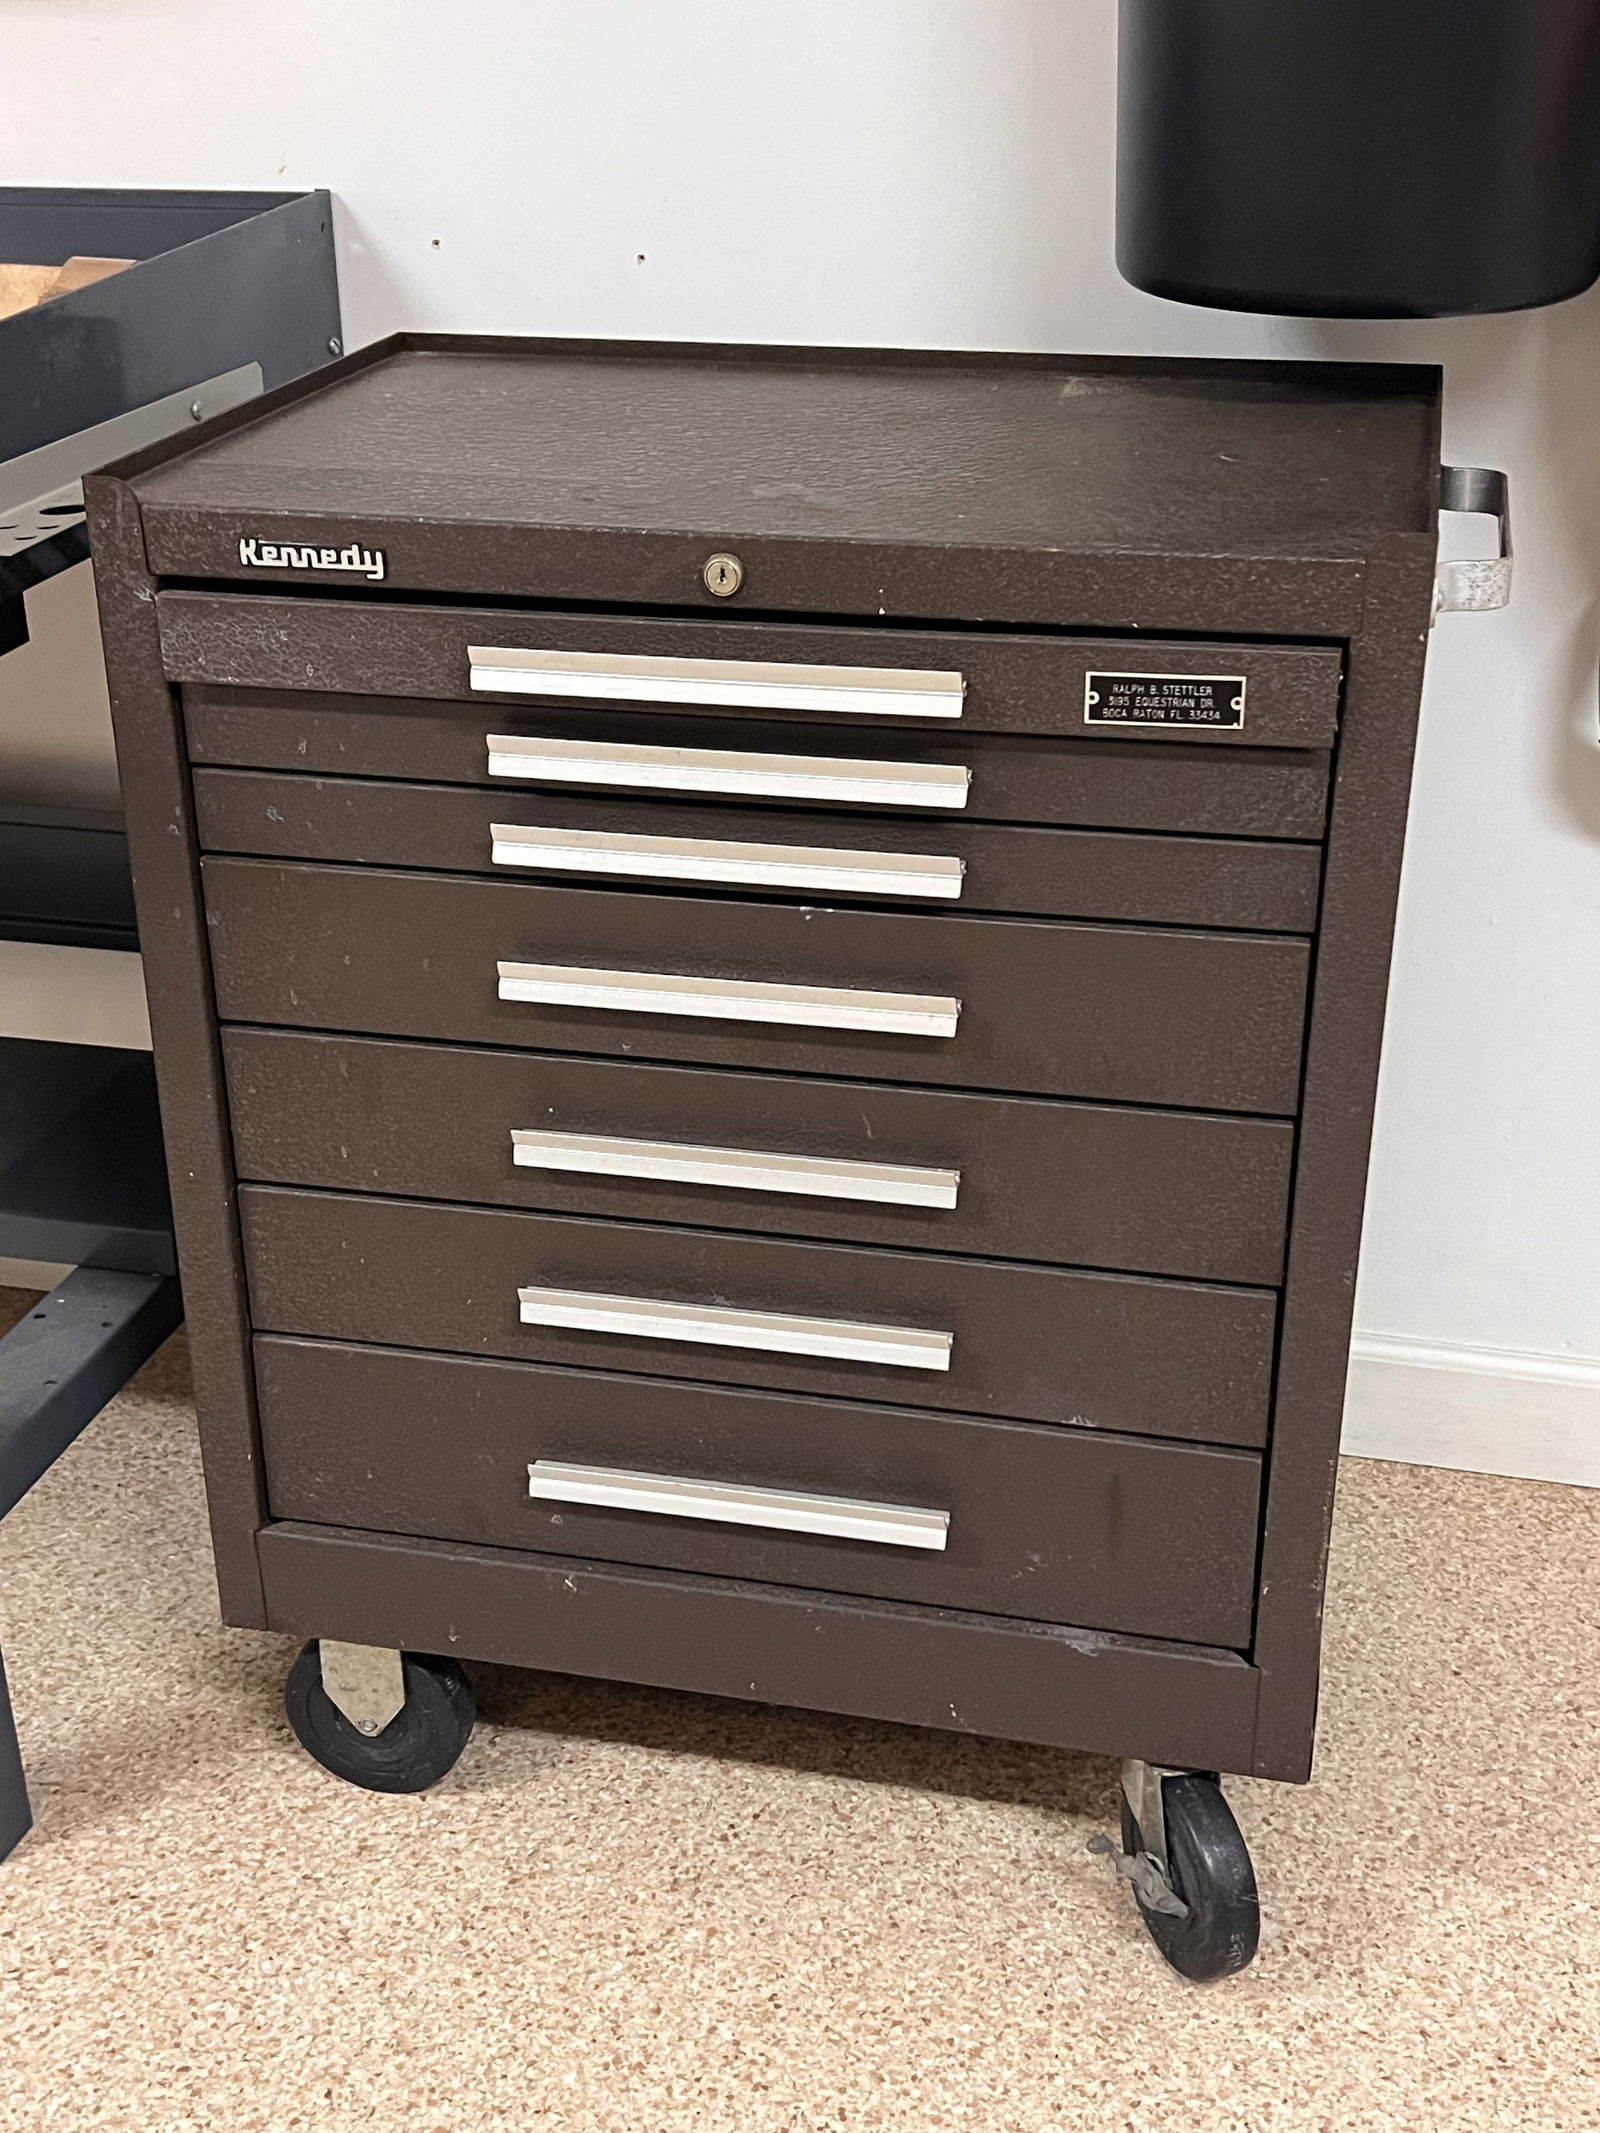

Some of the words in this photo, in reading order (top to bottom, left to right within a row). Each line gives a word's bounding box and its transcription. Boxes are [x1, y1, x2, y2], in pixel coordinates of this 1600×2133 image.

[239, 538, 385, 580] Kennedy
[1112, 683, 1145, 695] RALPH
[1163, 685, 1213, 696] STETTLER
[1135, 696, 1195, 708] EQUESTRIAN
[1132, 708, 1165, 720] RATON
[1189, 710, 1221, 721] 33434
